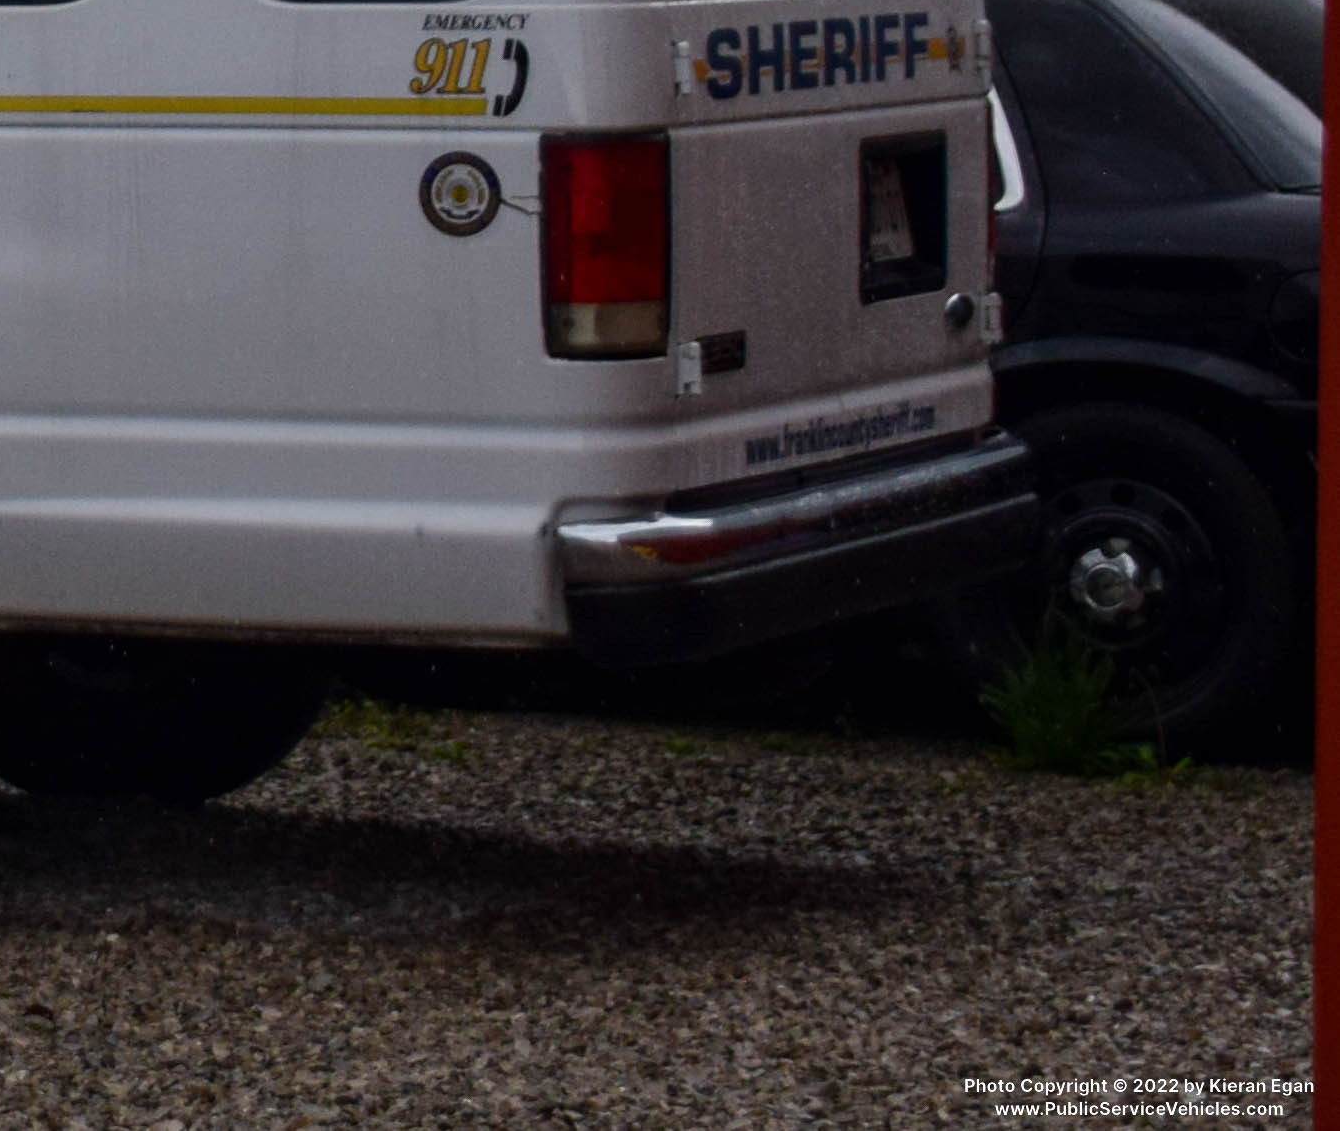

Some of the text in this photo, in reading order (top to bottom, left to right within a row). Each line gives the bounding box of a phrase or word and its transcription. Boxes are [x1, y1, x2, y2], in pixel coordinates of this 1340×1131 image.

[422, 13, 530, 30] EMERGENCY
[409, 37, 492, 94] 911
[706, 11, 929, 100] SHERIFF
